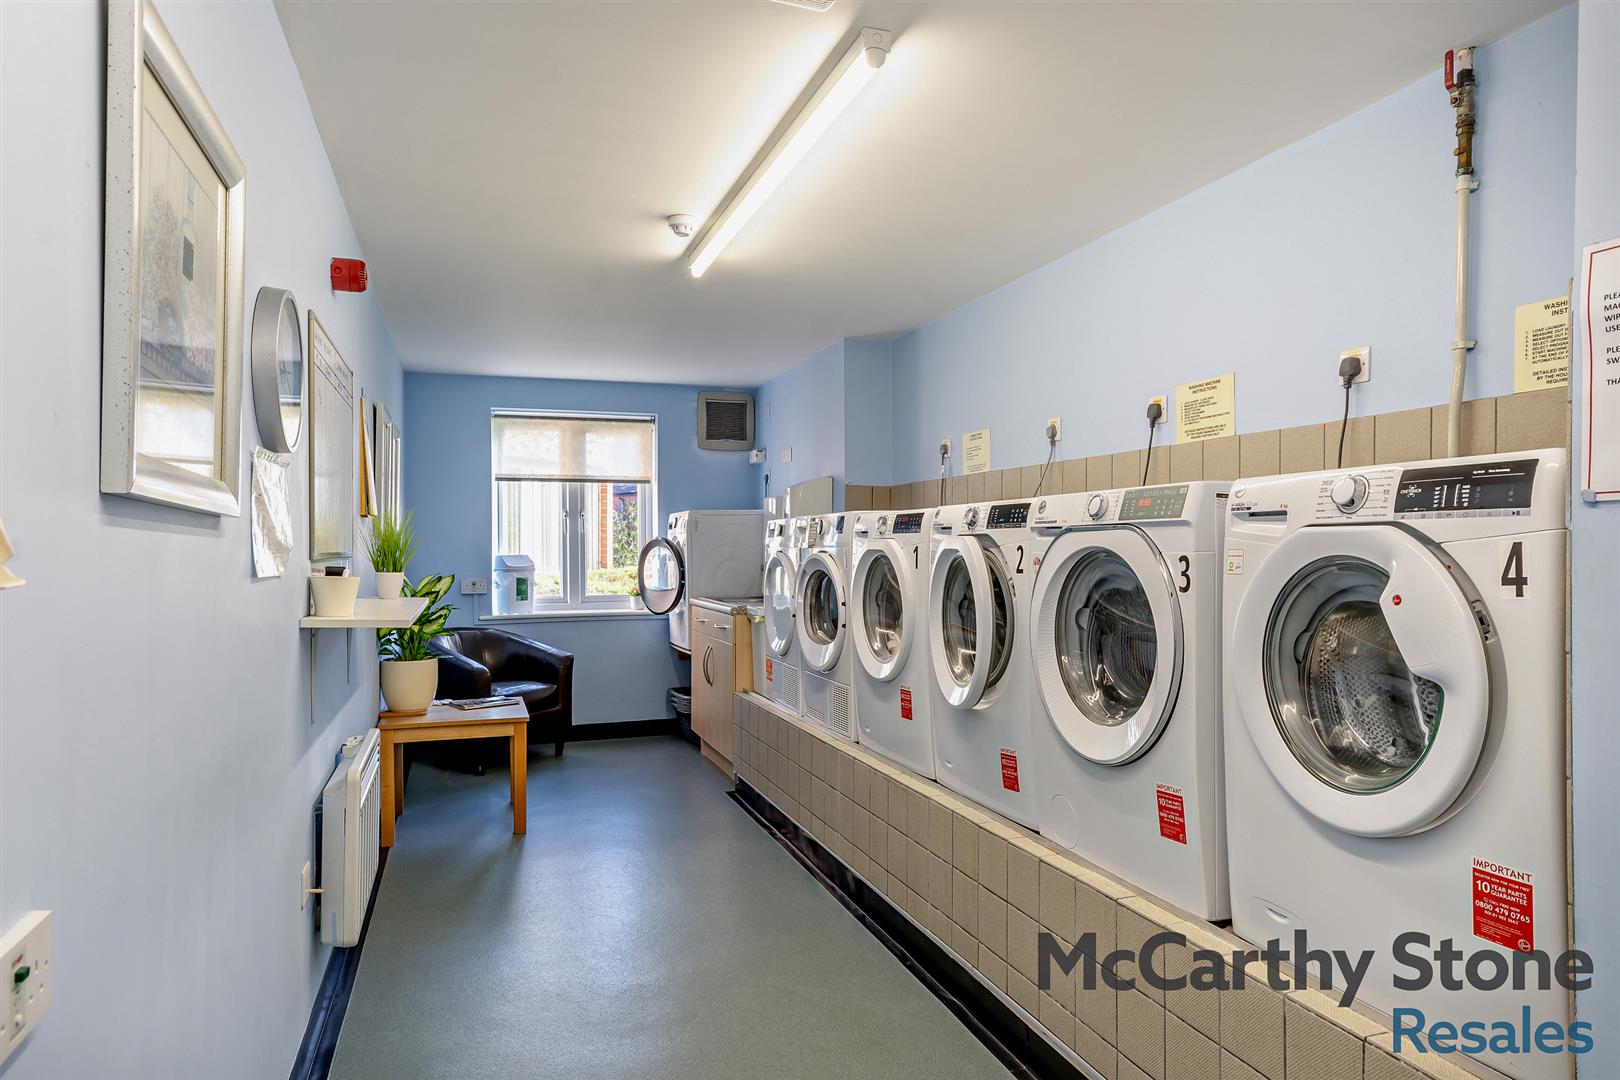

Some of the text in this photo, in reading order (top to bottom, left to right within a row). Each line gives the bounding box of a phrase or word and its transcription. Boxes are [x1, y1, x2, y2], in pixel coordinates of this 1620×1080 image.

[1544, 300, 1568, 310] WASHI
[1605, 324, 1620, 333] USE
[1606, 356, 1620, 365] SW
[913, 545, 919, 570] 1
[1016, 545, 1024, 574] 2
[1501, 541, 1528, 597] 4
[1178, 555, 1191, 593] 3
[1473, 857, 1532, 882] IMPORTANT
[1476, 880, 1527, 900] 10 YEAR PARTS
[1490, 890, 1528, 906] GUARANTEE
[1475, 900, 1531, 923] 0800 479 0765
